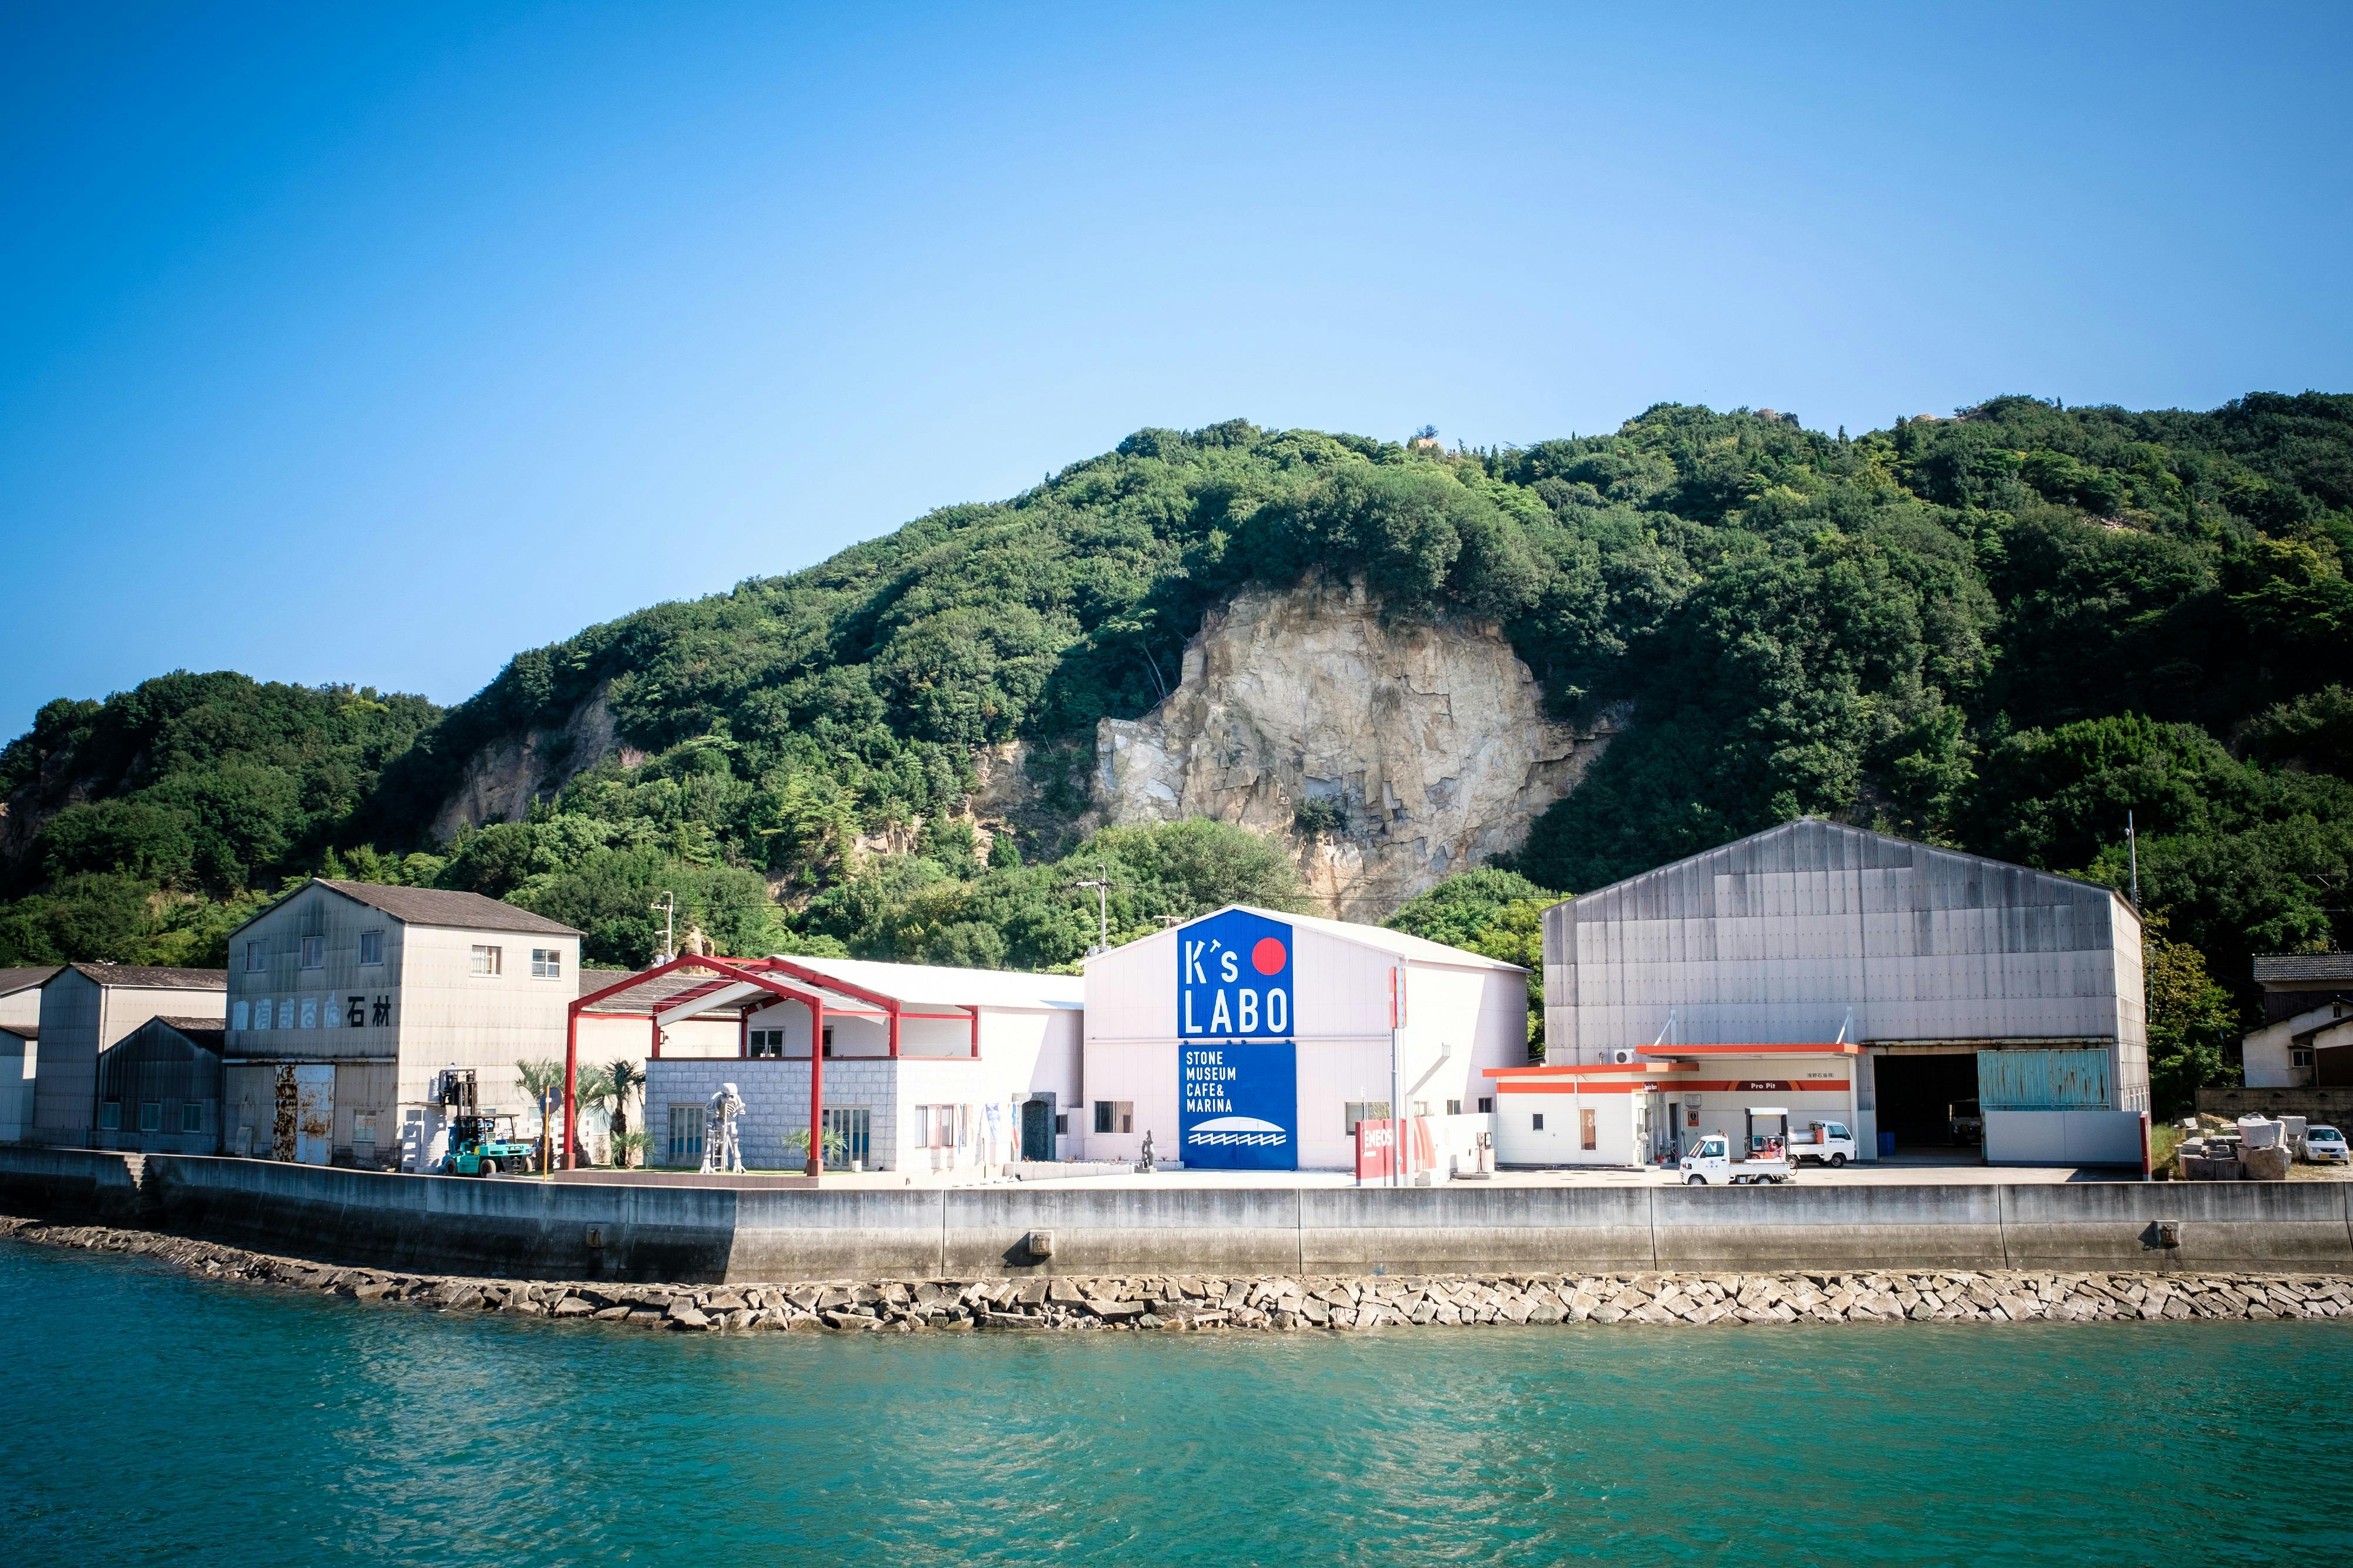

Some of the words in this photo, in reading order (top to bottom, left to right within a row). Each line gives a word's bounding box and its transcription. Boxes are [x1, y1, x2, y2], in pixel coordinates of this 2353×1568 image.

[1185, 939, 1238, 984] K's
[1185, 987, 1287, 1033] LABO
[1186, 1051, 1223, 1065] STONE
[1186, 1067, 1236, 1080] MUSEUM
[1187, 1099, 1232, 1112] MARINA
[1364, 1129, 1393, 1147] ENEOS
